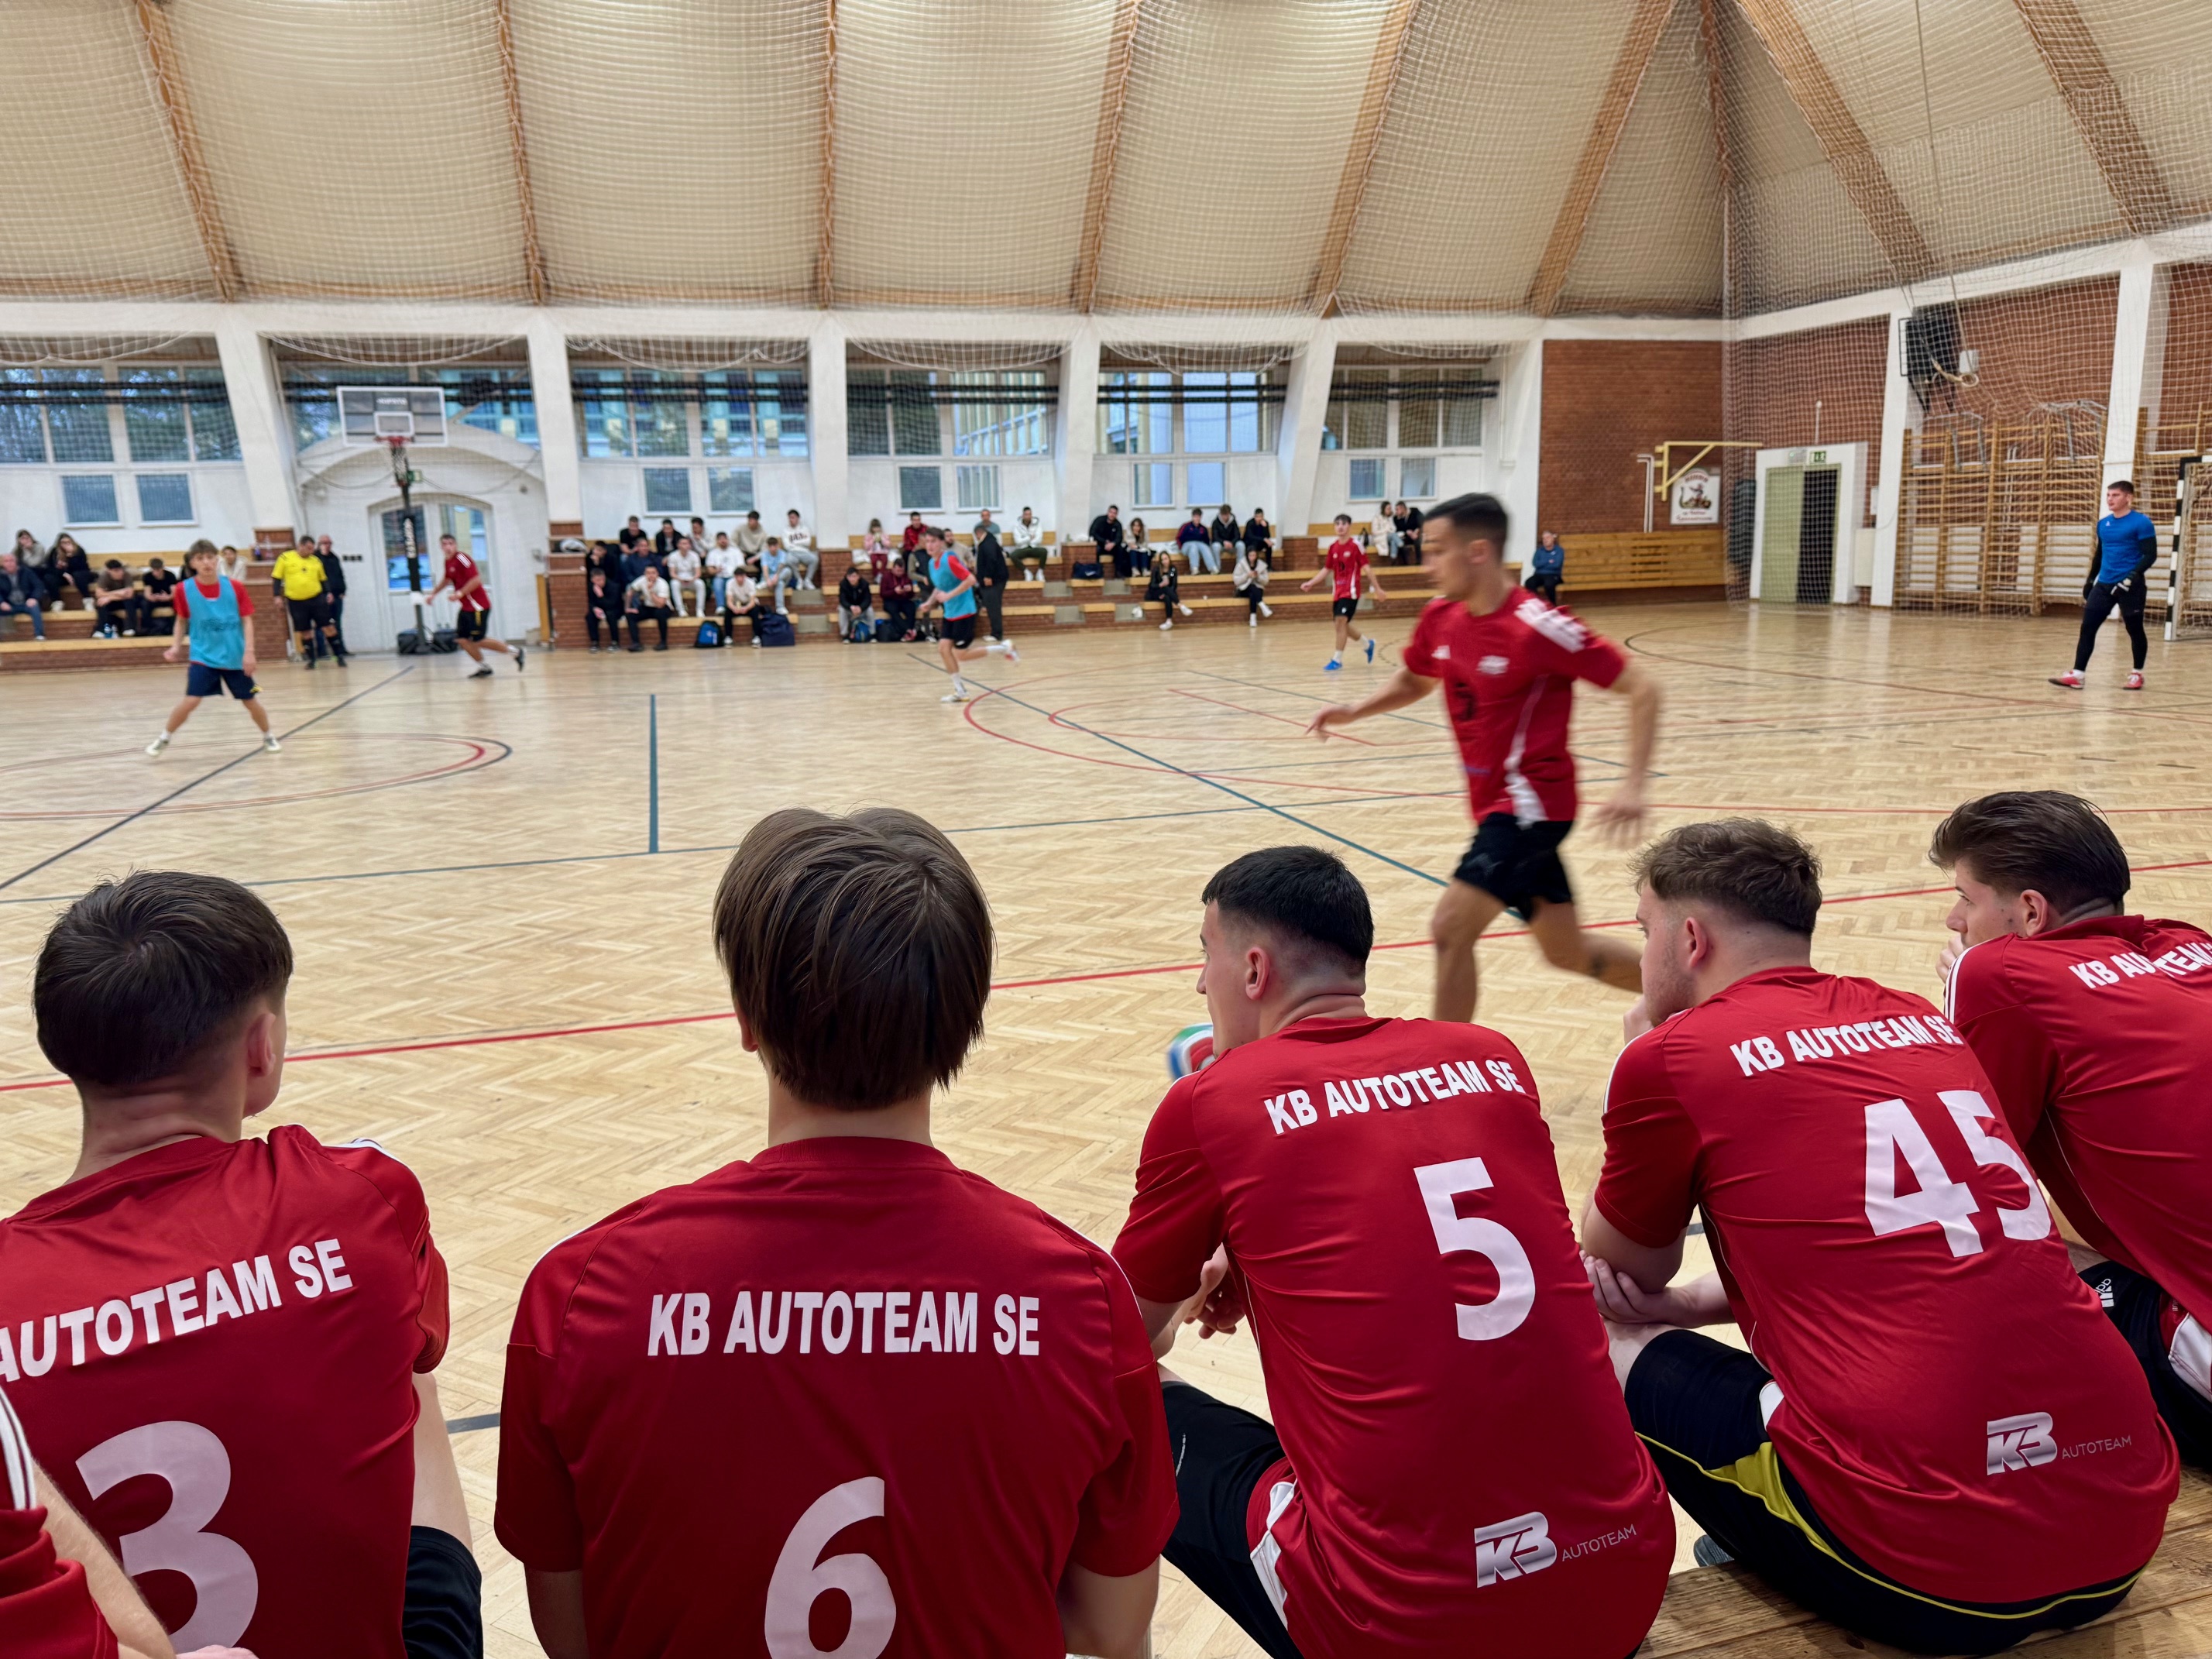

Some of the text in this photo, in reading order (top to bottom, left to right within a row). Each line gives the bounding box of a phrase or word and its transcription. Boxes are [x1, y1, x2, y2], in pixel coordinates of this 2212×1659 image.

[2068, 960, 2120, 989] KB
[1729, 1015, 1964, 1077] KB AUTOTEAM SE
[1264, 1059, 1527, 1135] KB AUTOTEAM SE
[1864, 1089, 2051, 1258] 45
[289, 1238, 353, 1299] SE
[1413, 1157, 1535, 1341] 5
[648, 1291, 1039, 1356] KB AUTOTEAM SE
[1987, 1412, 2131, 1476] KB AUTOTEAM
[75, 1420, 259, 1650] 3
[764, 1476, 897, 1659] 6
[1474, 1511, 1637, 1589] KB AUTOTEAM
